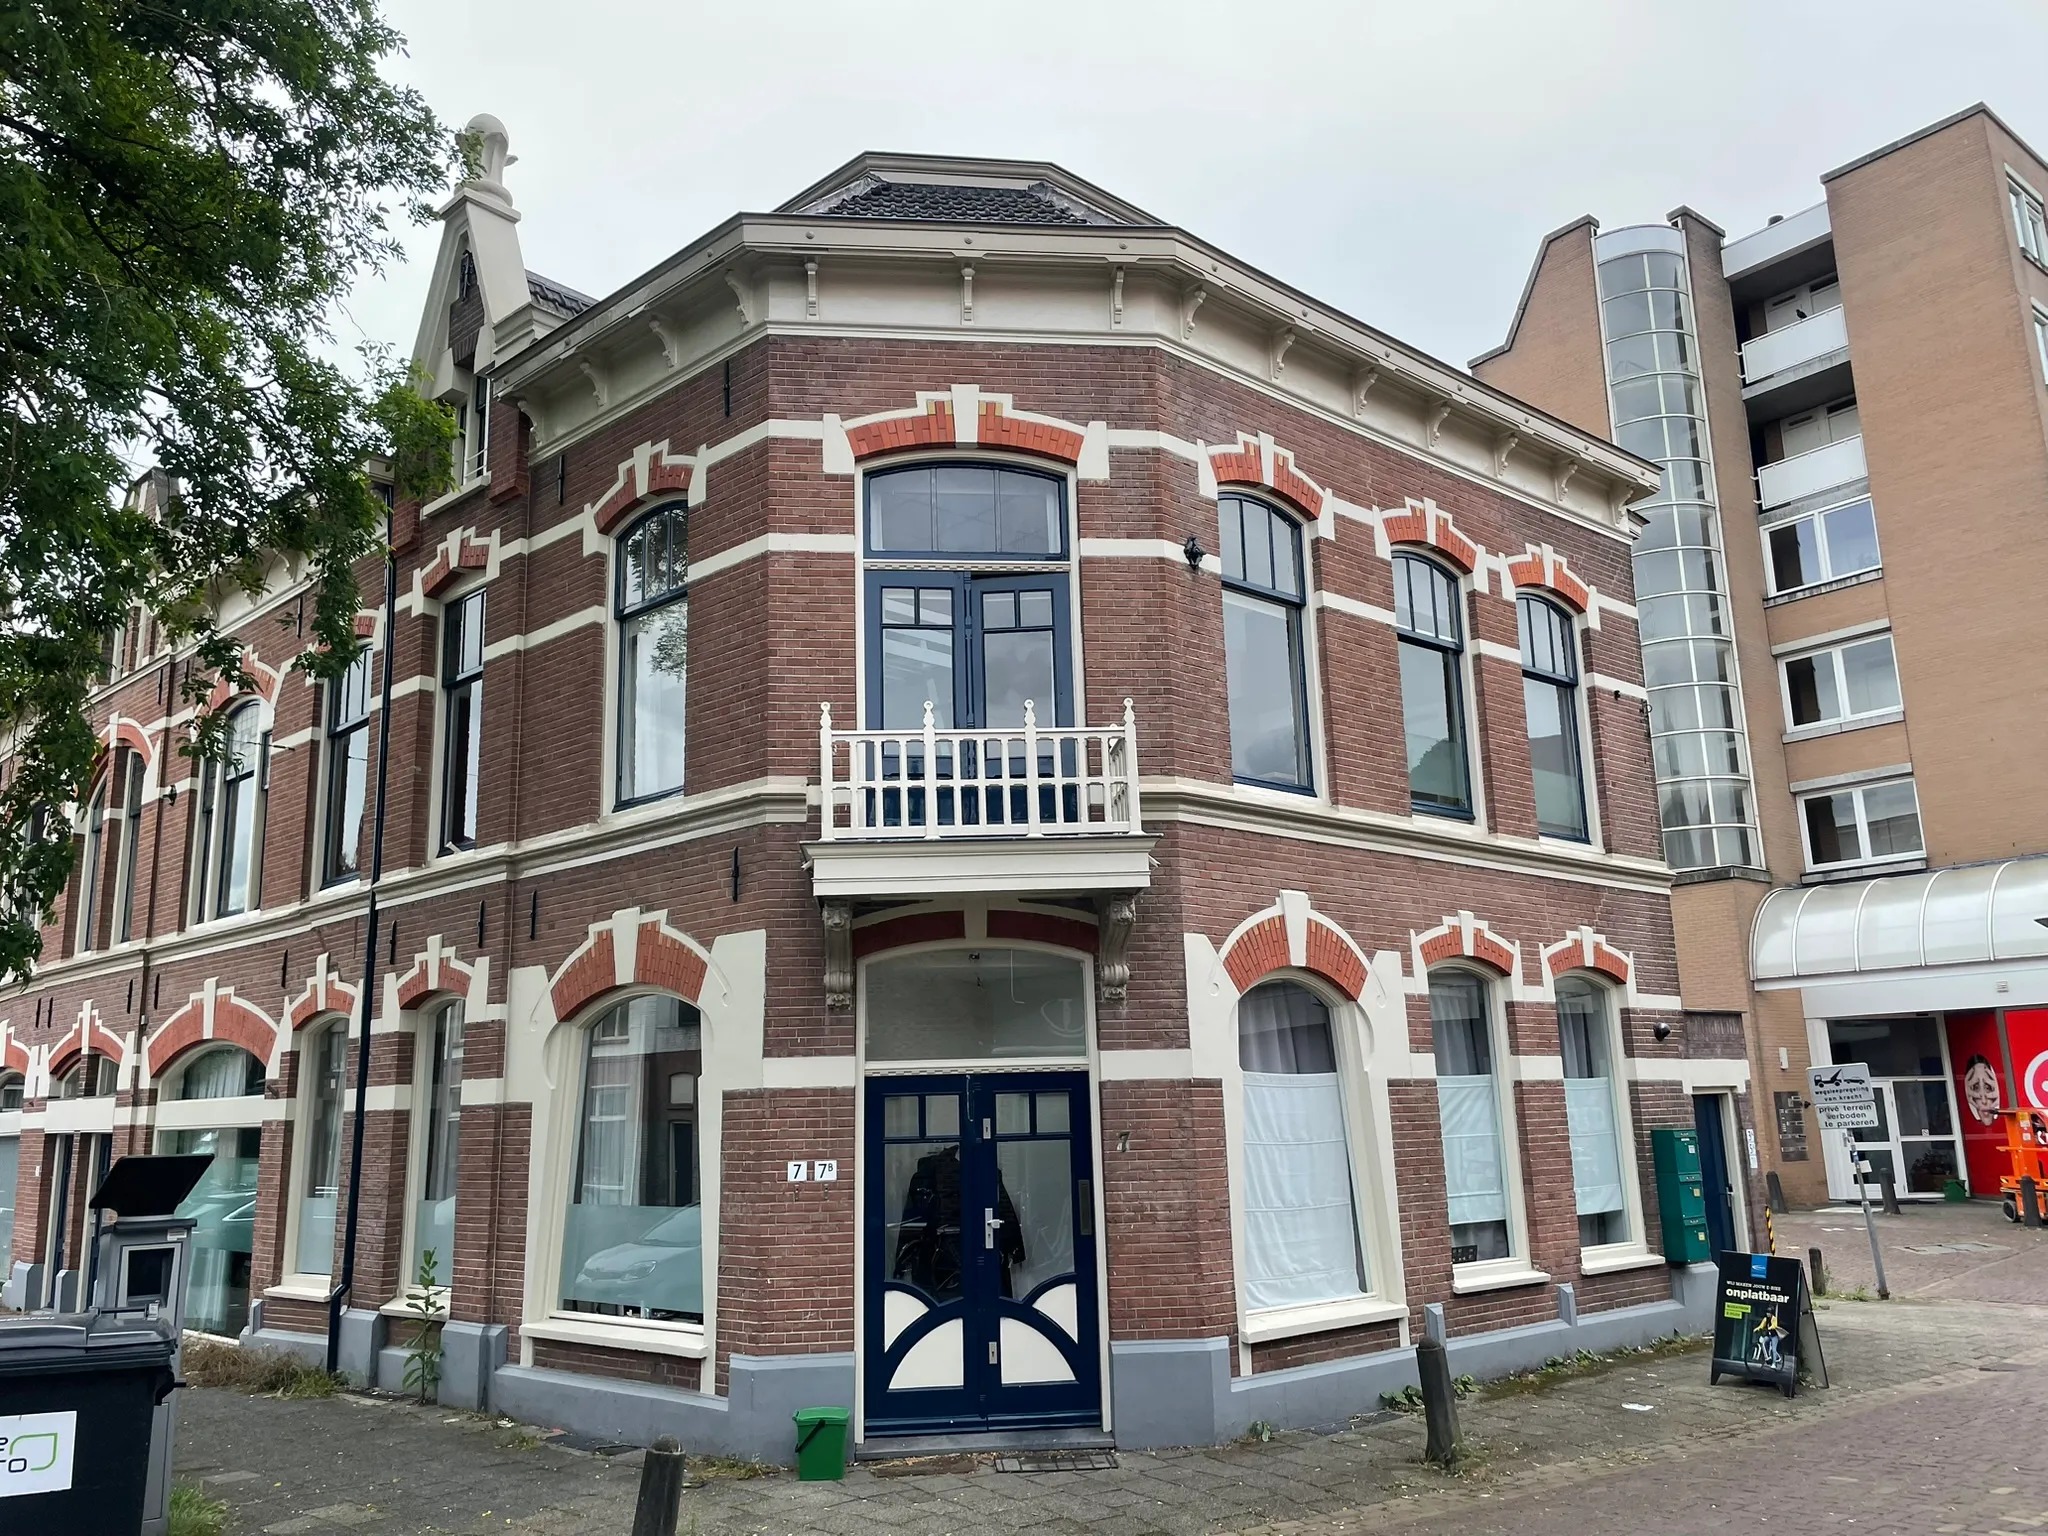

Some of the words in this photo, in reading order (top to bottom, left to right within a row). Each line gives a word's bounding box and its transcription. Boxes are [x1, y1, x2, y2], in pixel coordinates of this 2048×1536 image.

[1826, 1112, 1867, 1120] verboden
[1837, 1119, 1875, 1128] parkeren
[1119, 1131, 1130, 1153] 7
[793, 1164, 801, 1179] 7
[1725, 1288, 1790, 1303] onplatbaar
